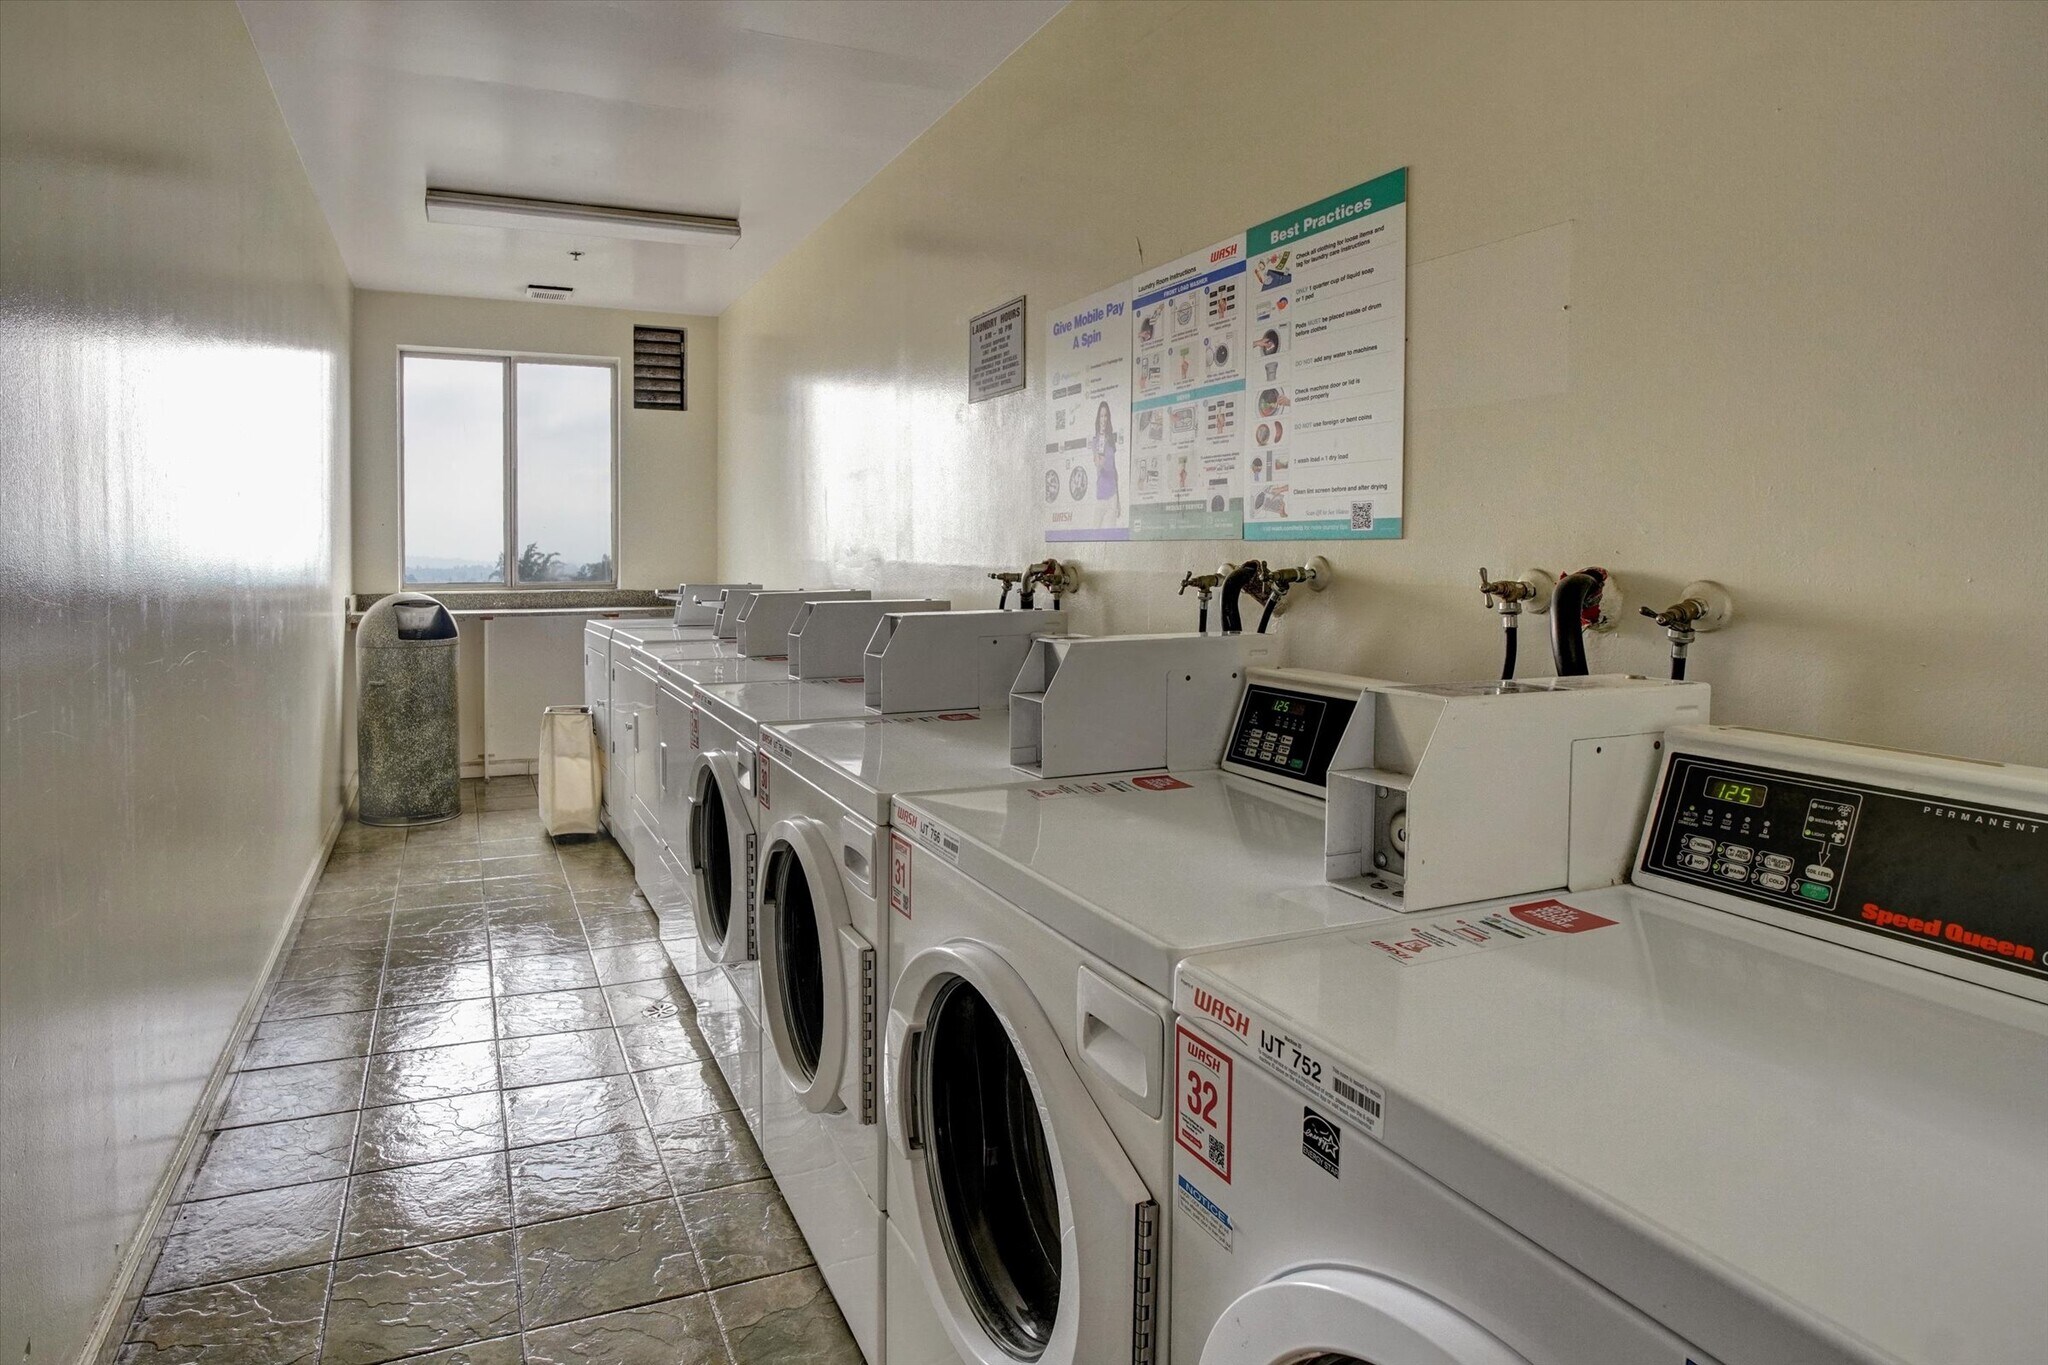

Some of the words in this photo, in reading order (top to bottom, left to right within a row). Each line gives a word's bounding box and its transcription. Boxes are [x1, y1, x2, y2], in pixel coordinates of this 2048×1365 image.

[1271, 223, 1299, 245] Best
[1304, 198, 1372, 232] Practices
[1210, 244, 1237, 262] WASH
[1296, 251, 1309, 260] Check
[1317, 242, 1336, 253] clothing
[1345, 234, 1358, 243] loose
[1359, 230, 1373, 239] items
[1375, 225, 1384, 233] and
[1311, 253, 1328, 263] laundry
[1341, 239, 1370, 252] instructions
[1138, 281, 1155, 292] Laundry
[1156, 277, 1168, 285] Room
[1170, 267, 1196, 280] Instructions
[1313, 281, 1329, 291] quarter
[1347, 269, 1360, 280] liquid
[1362, 267, 1374, 276] soap
[1305, 293, 1314, 301] pod
[972, 317, 997, 335] LAUNDRY
[1000, 307, 1020, 323] HOURS
[1053, 321, 1072, 336] Give
[1074, 308, 1104, 329] Mobile
[1106, 302, 1124, 317] Pay
[1329, 312, 1344, 321] placed
[1346, 308, 1361, 317] inside
[1005, 323, 1012, 332] PM
[1073, 336, 1079, 349] A
[1081, 329, 1101, 347] Spin
[1311, 325, 1327, 334] clothes
[1353, 344, 1377, 354] machines
[1310, 384, 1329, 392] machine
[1310, 392, 1329, 401] properly
[1332, 485, 1347, 493] before
[1371, 483, 1387, 491] drying
[897, 806, 917, 828] WASH
[1923, 806, 2039, 833] PERMANENT
[895, 859, 905, 888] 31
[1861, 902, 1942, 937] Speed
[1944, 923, 2035, 961] Queen
[1194, 987, 1250, 1037] WASH
[1187, 1042, 1220, 1073] WASH
[1261, 1029, 1285, 1058] IJT
[1292, 1048, 1321, 1083] 752
[1187, 1069, 1218, 1129] 32
[1303, 1146, 1323, 1165] ENERGY
[1324, 1161, 1338, 1175] STAR
[1185, 1181, 1228, 1222] NOTICE
